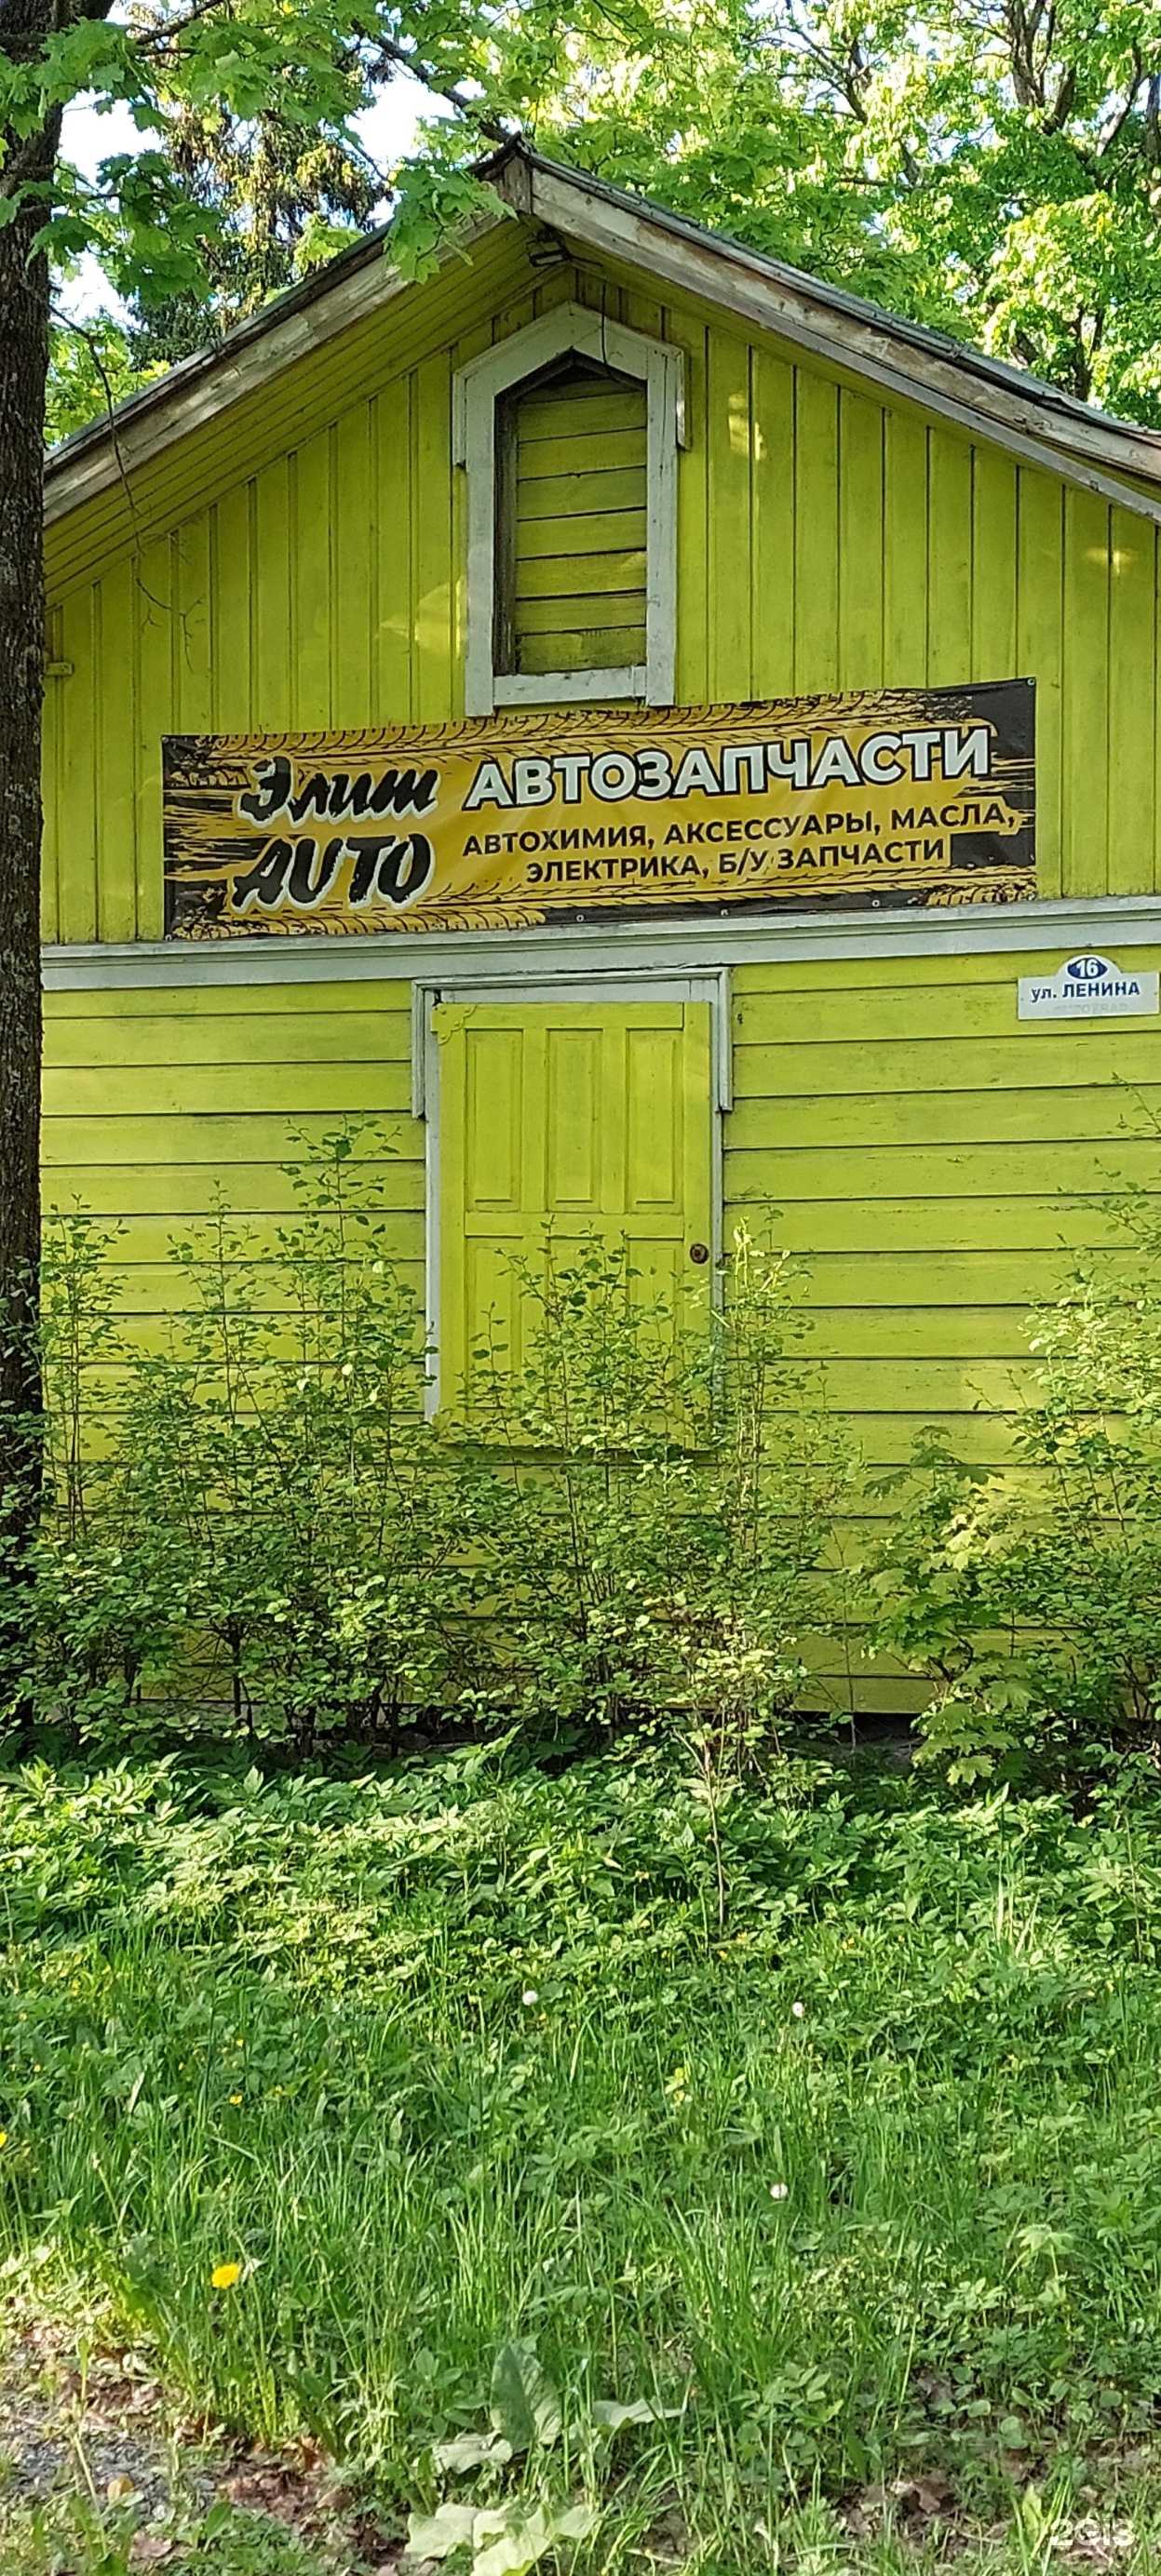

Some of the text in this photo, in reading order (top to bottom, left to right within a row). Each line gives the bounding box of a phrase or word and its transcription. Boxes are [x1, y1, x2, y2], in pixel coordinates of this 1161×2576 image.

[236, 756, 440, 825] Элит
[462, 727, 991, 811] АВТОЗАПЧАСТИ
[462, 802, 1017, 857] АВТОХИМИЯ, АКСЕССУАРЫ, МАСЛА,
[231, 833, 435, 910] AUTO
[525, 839, 945, 883] ЭЛЕКТРИКА, Б/У ЗАПЧАСТИ
[1031, 981, 1141, 1003] ул. ЛЕНИНА
[1075, 959, 1099, 977] 16
